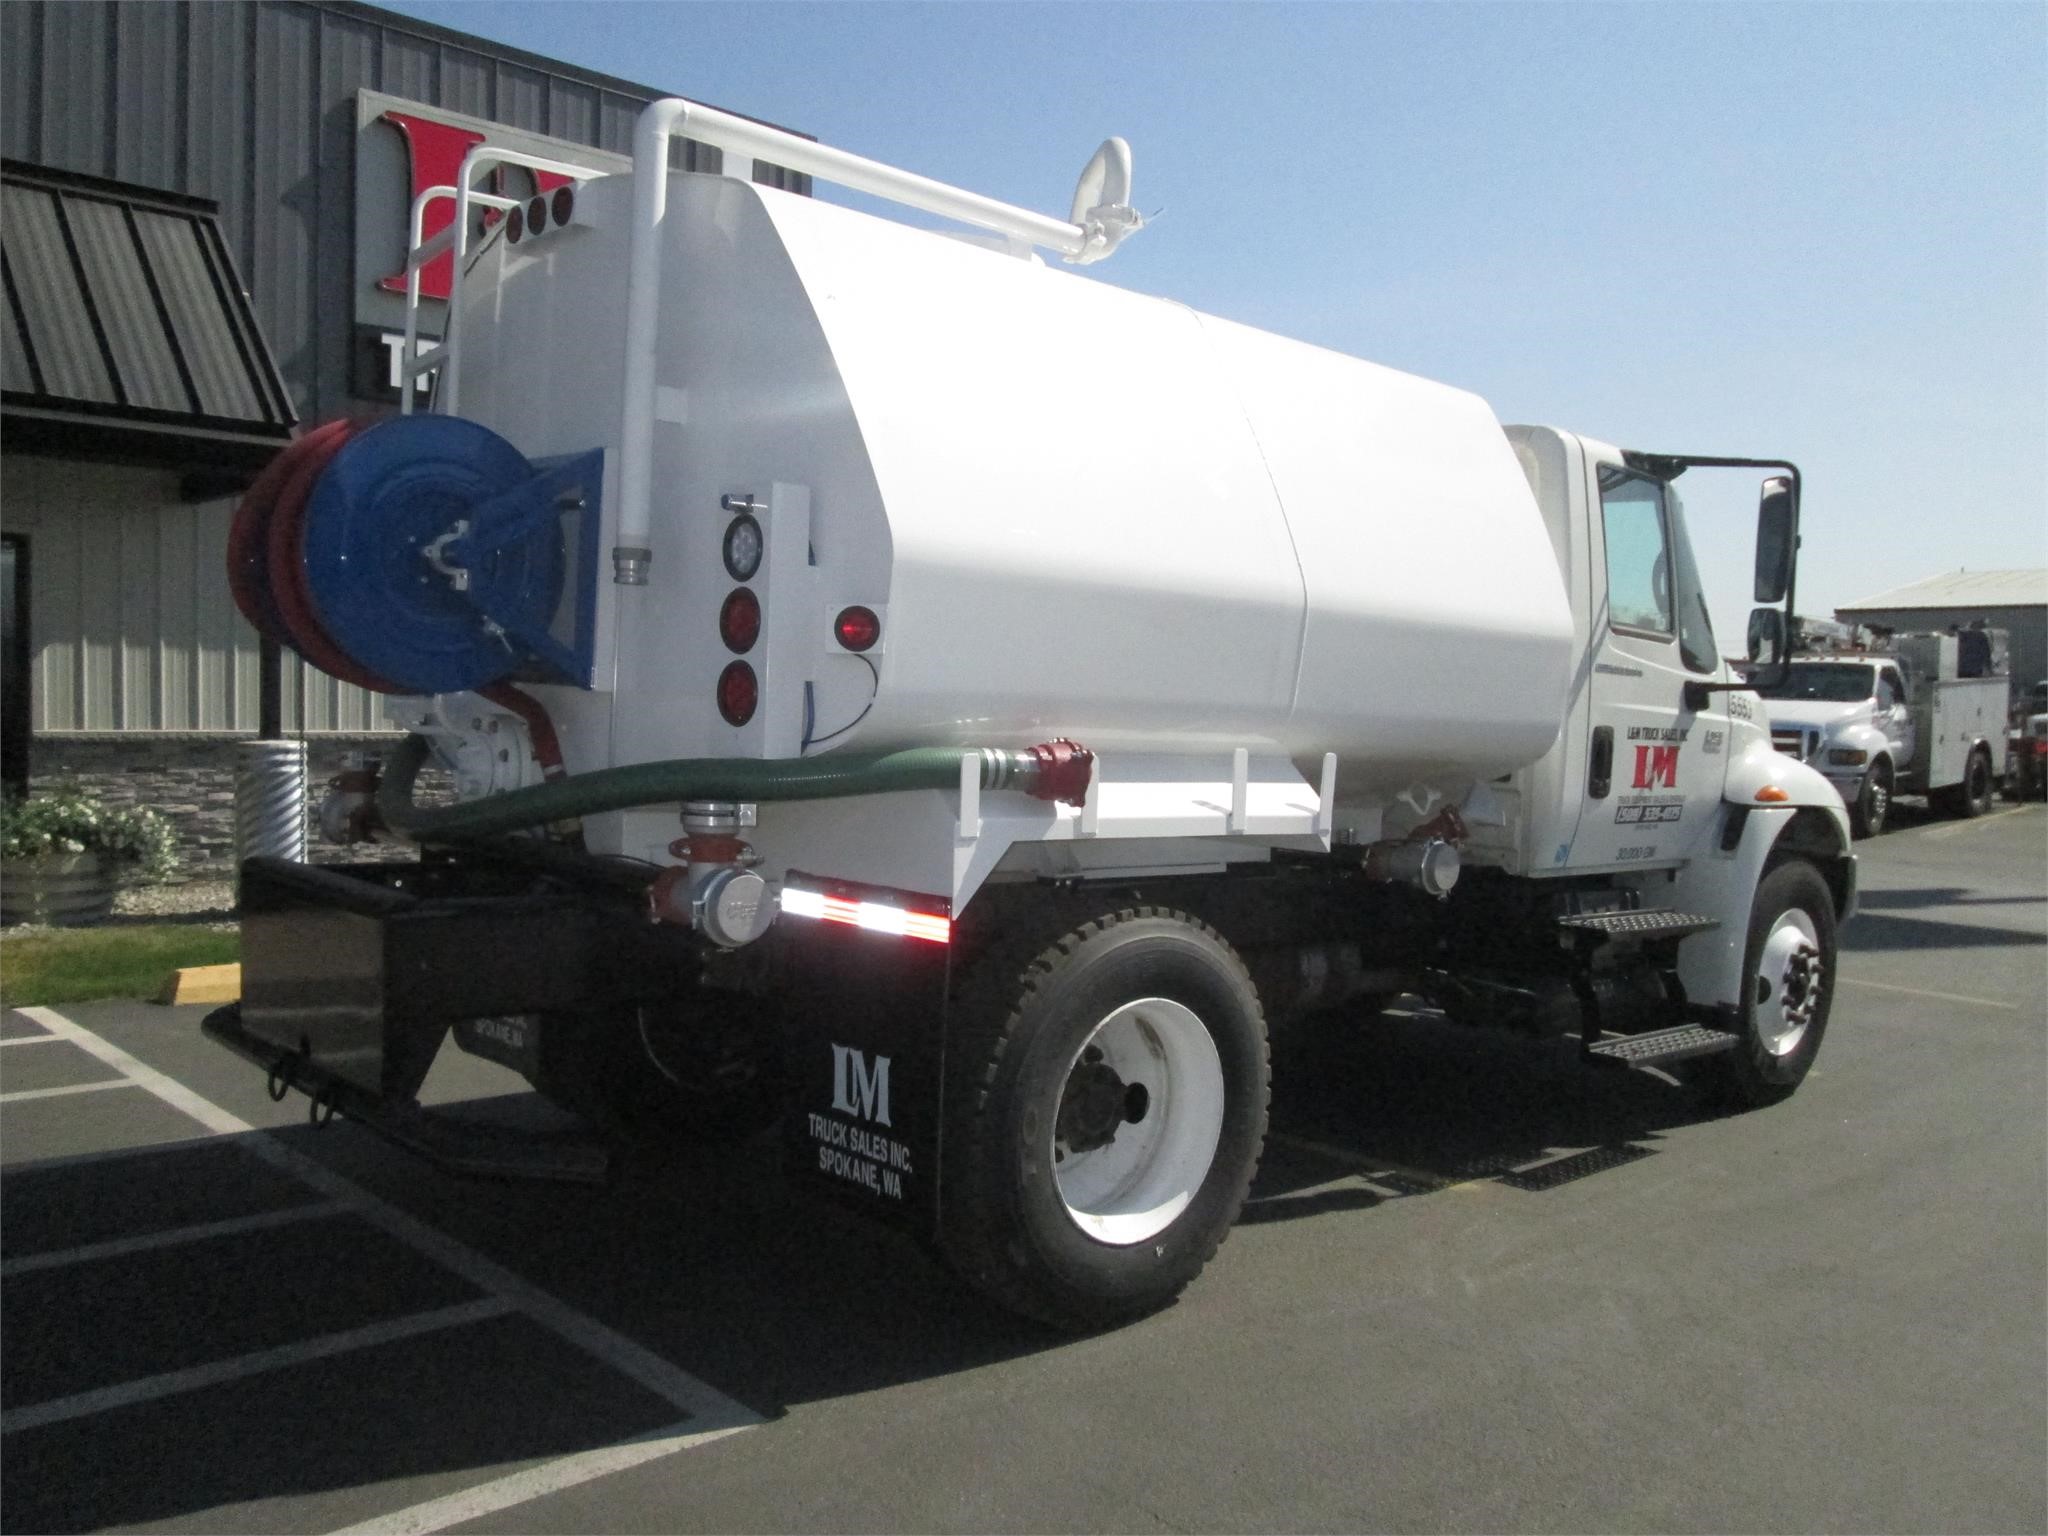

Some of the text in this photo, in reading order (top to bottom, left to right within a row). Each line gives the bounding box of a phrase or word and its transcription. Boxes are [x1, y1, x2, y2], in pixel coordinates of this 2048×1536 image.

[1631, 745, 1680, 790] LM
[831, 1042, 892, 1128] LM
[808, 1112, 848, 1148] TRUCK
[849, 1127, 888, 1163] SALES
[819, 1146, 903, 1201] SPOKANE, WA
